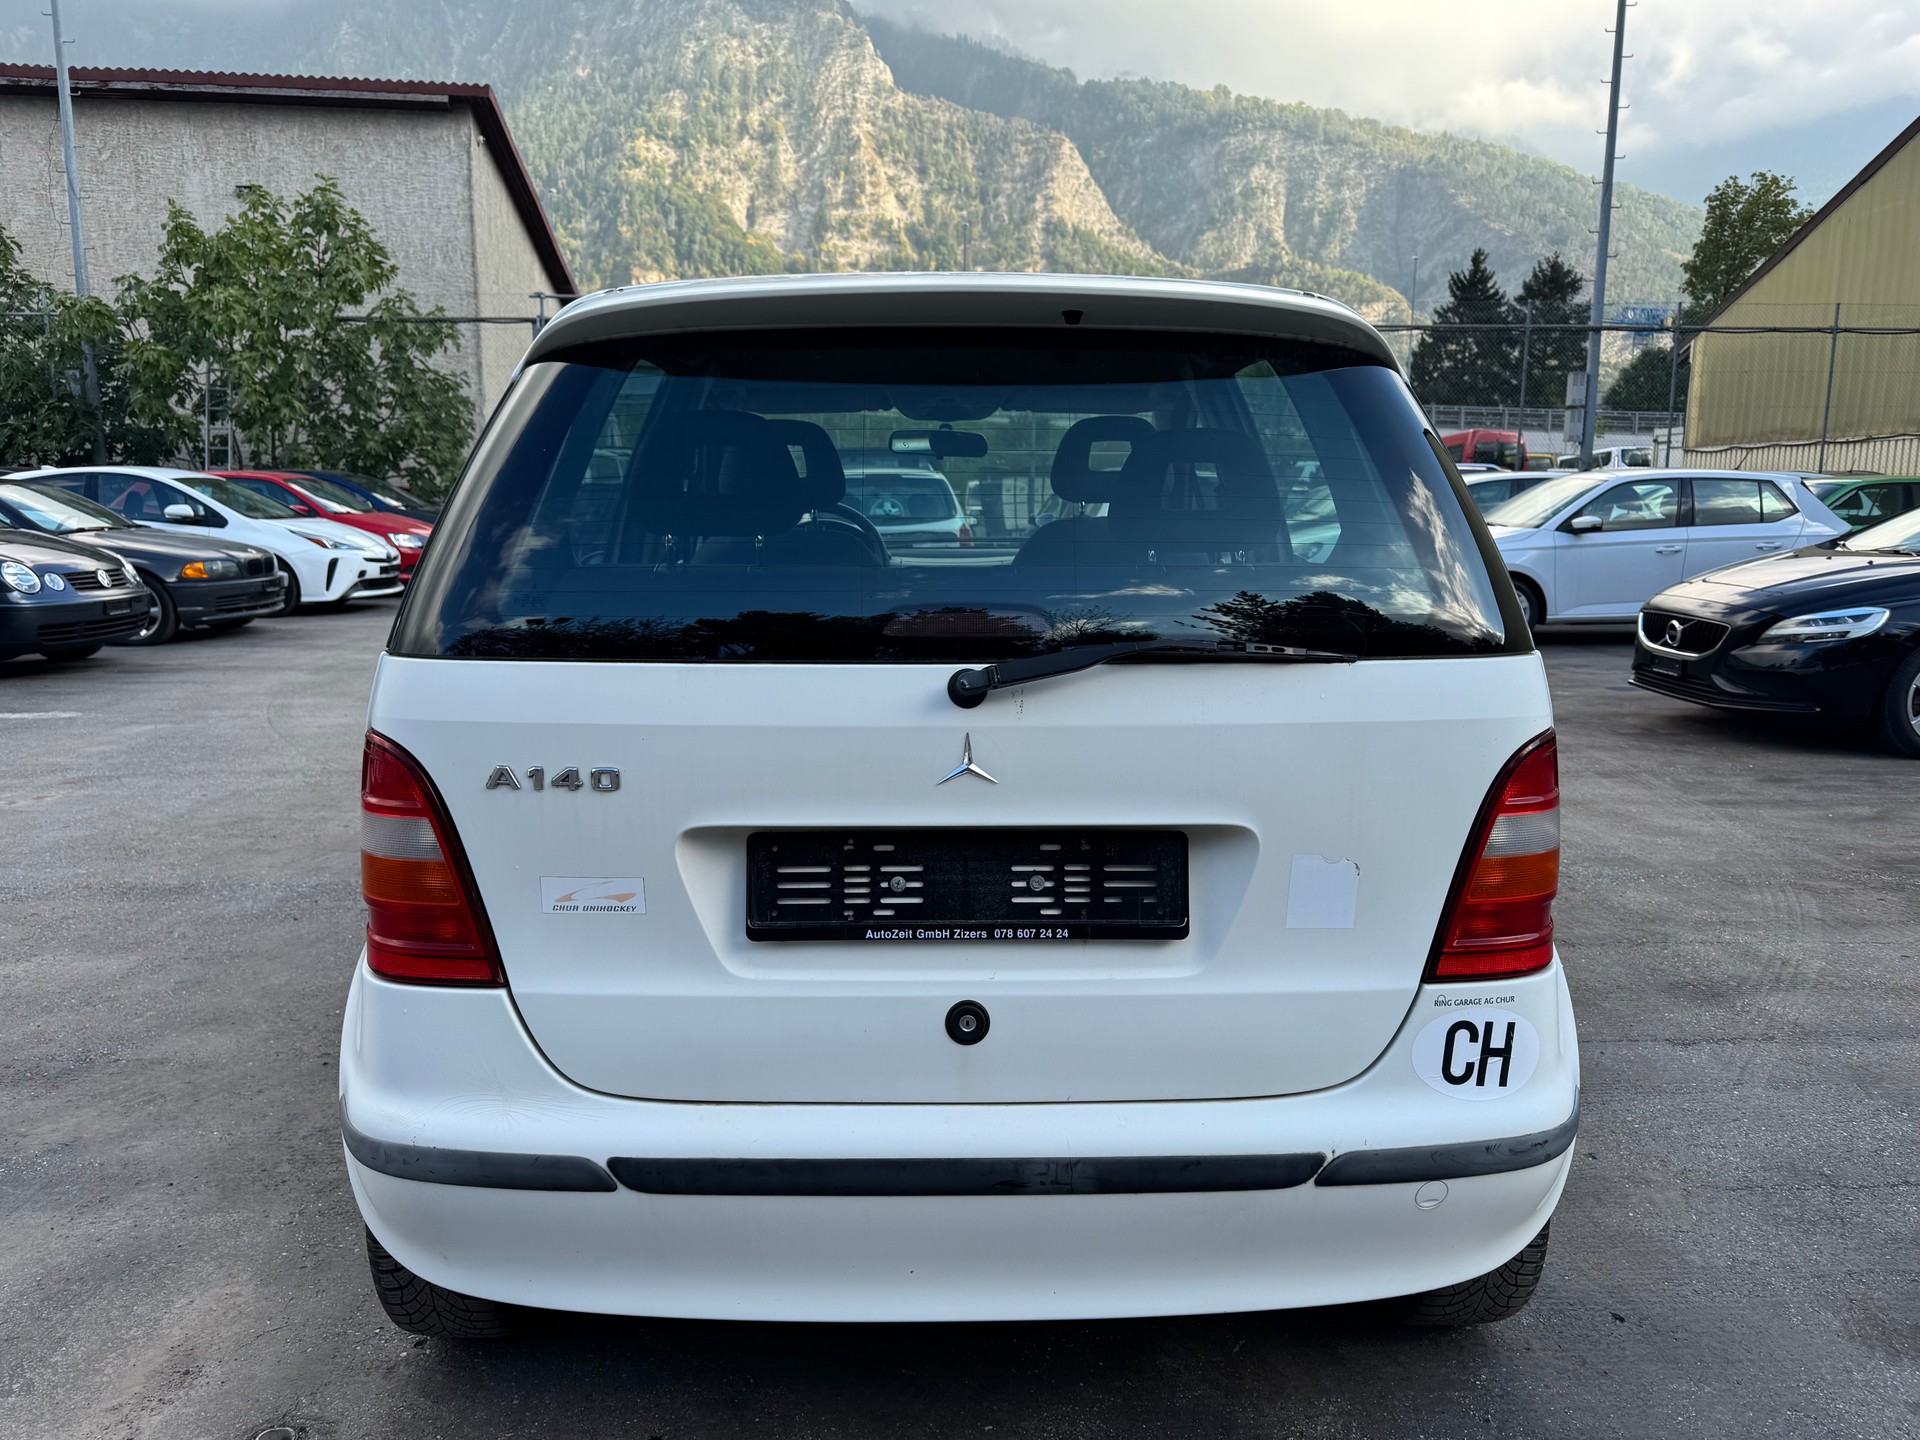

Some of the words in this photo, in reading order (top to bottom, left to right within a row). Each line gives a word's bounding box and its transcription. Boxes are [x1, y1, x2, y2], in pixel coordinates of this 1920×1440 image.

[552, 904, 579, 913] CHUR
[582, 905, 637, 913] UNIHOCKEY
[865, 928, 913, 939] AutoZeit
[916, 928, 950, 939] GmbH
[953, 928, 987, 939] Zizers
[994, 928, 1014, 939] 078
[1017, 928, 1036, 939] 607
[1040, 928, 1052, 939] 24
[1056, 928, 1069, 939] 24
[1434, 999, 1452, 1007] RING
[1454, 998, 1482, 1007] GARAGE
[1484, 997, 1494, 1005] AG
[1495, 995, 1515, 1004] CHUR
[1442, 1020, 1516, 1087] CH
